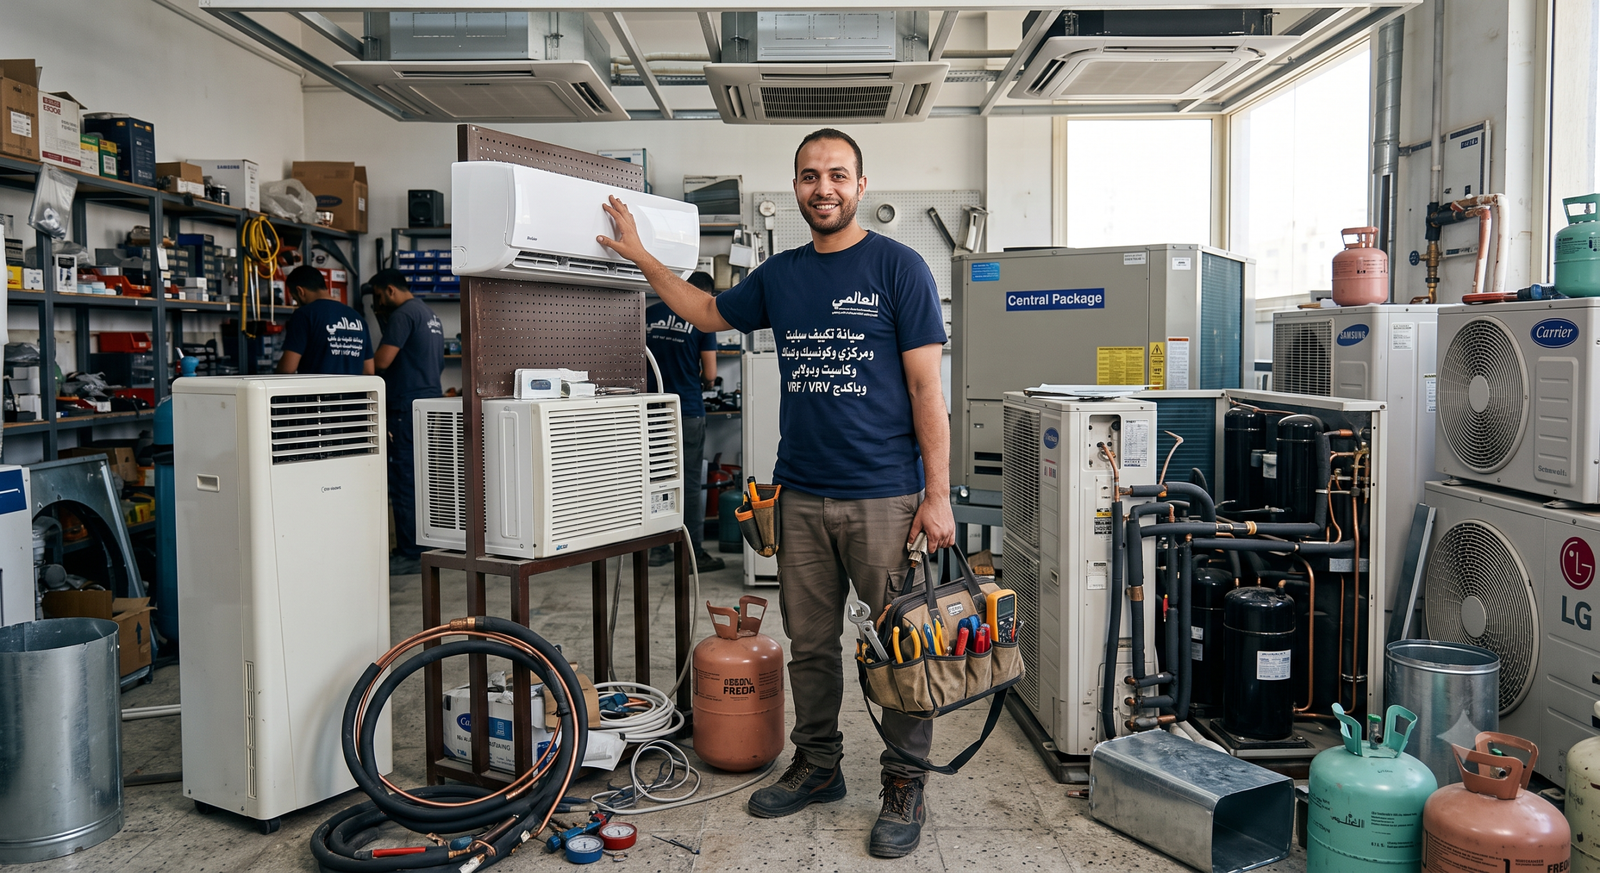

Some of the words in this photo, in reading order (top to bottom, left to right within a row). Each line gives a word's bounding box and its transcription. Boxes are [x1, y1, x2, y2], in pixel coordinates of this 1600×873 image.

[832, 291, 879, 309] العالمي
[1008, 294, 1049, 306] Central
[1052, 293, 1102, 306] Package
[326, 317, 363, 335] العالمي
[1536, 325, 1573, 339] Carrier
[808, 328, 835, 343] تكييف
[836, 328, 865, 343] صيانة
[1340, 330, 1366, 340] SAMSUNG
[838, 346, 874, 361] ومركزي
[821, 364, 857, 378] وكاسيت
[787, 382, 801, 392] VRF
[808, 382, 830, 392] VRV
[832, 382, 867, 397] وباكدج
[1561, 595, 1592, 631] LG
